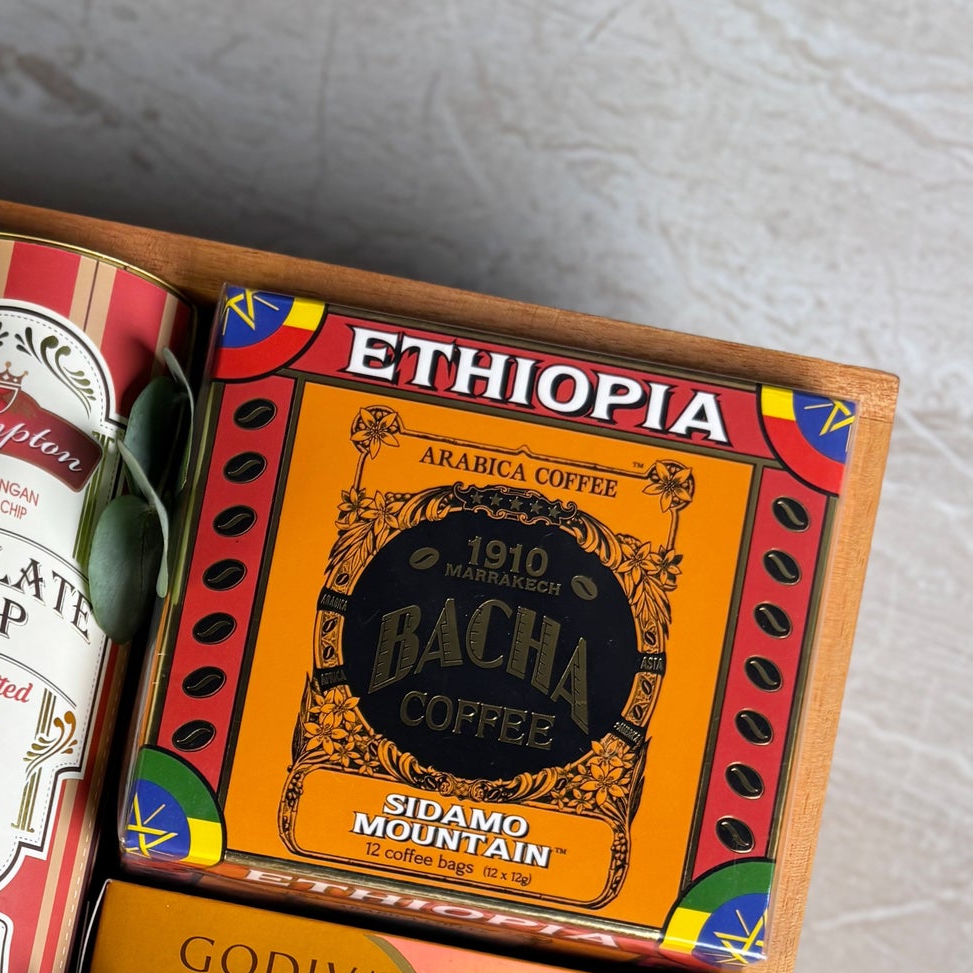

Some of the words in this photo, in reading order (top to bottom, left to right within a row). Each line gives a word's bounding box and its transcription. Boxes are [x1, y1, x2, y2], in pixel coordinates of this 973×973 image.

[345, 324, 731, 445] ETHIOPIA
[419, 445, 527, 482] ARABICA
[535, 466, 618, 498] COFFEE
[0, 498, 28, 520] CHIP
[445, 562, 562, 596] MARRAKECH
[467, 534, 550, 577] 1910
[368, 597, 590, 735] BACHA
[640, 655, 664, 671] ASIA
[400, 690, 556, 749] COFFEE
[382, 792, 530, 839] SIDAMO
[365, 840, 381, 858] 12
[384, 844, 435, 868] coffee
[437, 853, 474, 876] bags
[482, 865, 498, 881] (12
[509, 869, 532, 887] 12g)
[243, 868, 621, 950] ETHIOPIA
